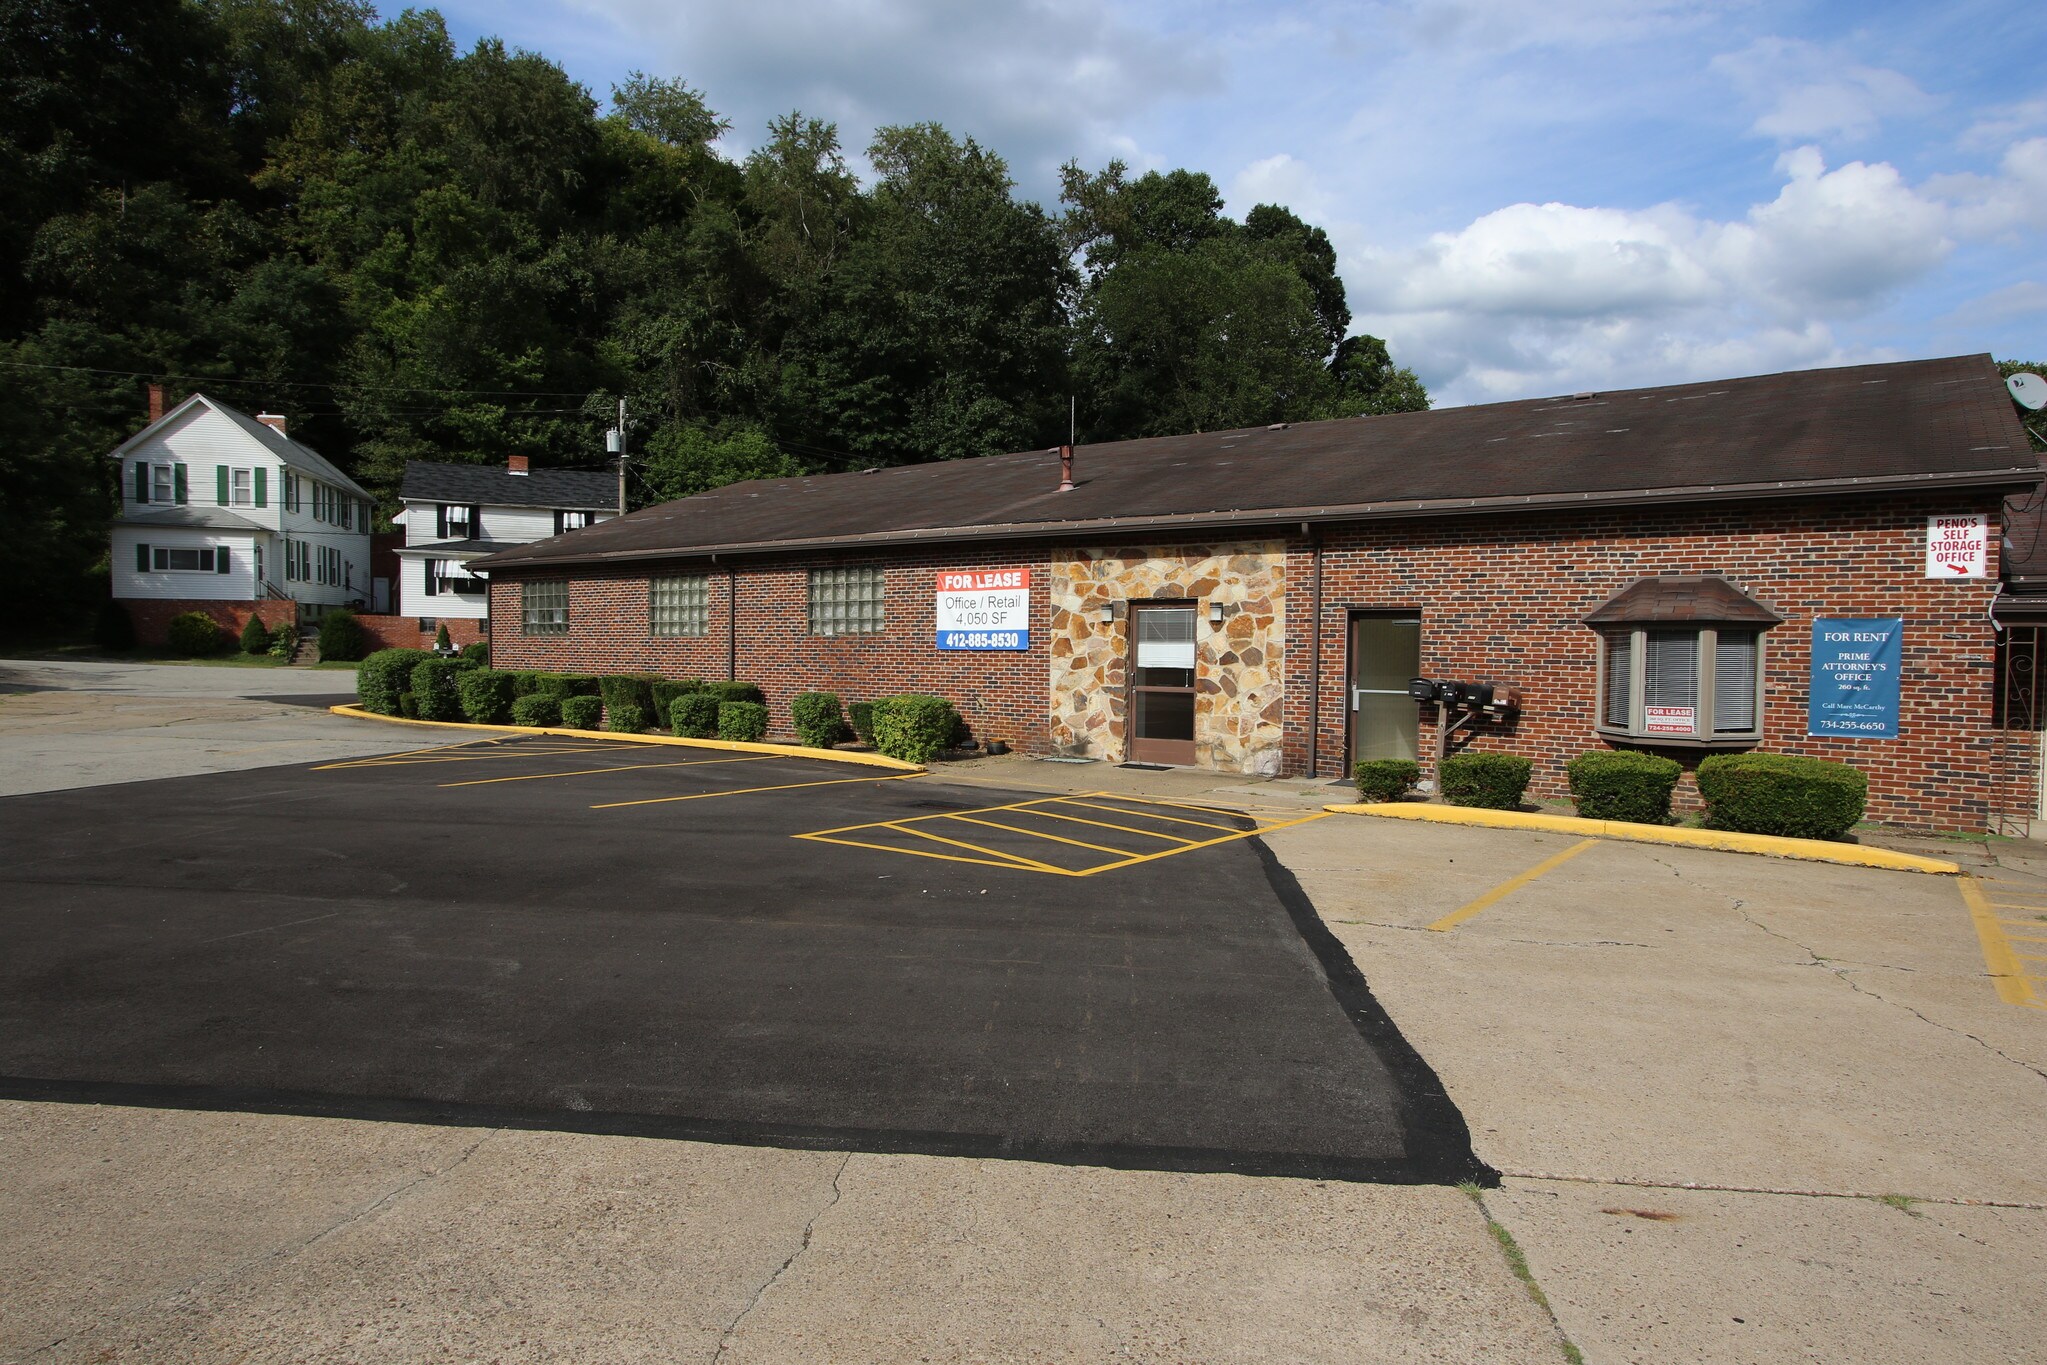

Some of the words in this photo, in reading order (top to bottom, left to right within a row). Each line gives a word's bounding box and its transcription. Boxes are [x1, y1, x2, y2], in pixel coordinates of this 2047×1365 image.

[1936, 517, 1978, 529] PENO'S
[1943, 529, 1970, 540] SELF
[1930, 540, 1982, 552] STORAGE
[1936, 552, 1975, 562] OFFICE
[945, 575, 973, 589] FOR
[975, 572, 1022, 588] LEASE
[945, 596, 977, 609] Office
[980, 596, 984, 608] /
[988, 595, 1021, 608] Retail
[956, 612, 988, 626] 4,050
[991, 611, 1008, 625] SF
[946, 632, 1019, 648] 412-885-8530
[1824, 632, 1850, 642] FOR
[1854, 632, 1889, 642] RENT
[1838, 652, 1870, 660] PRIME
[1821, 662, 1887, 671] ATTORNEY'S
[1834, 673, 1872, 681] OFFICE
[1854, 703, 1885, 712] McCarthy
[1820, 720, 1885, 730] 734-255-6650
